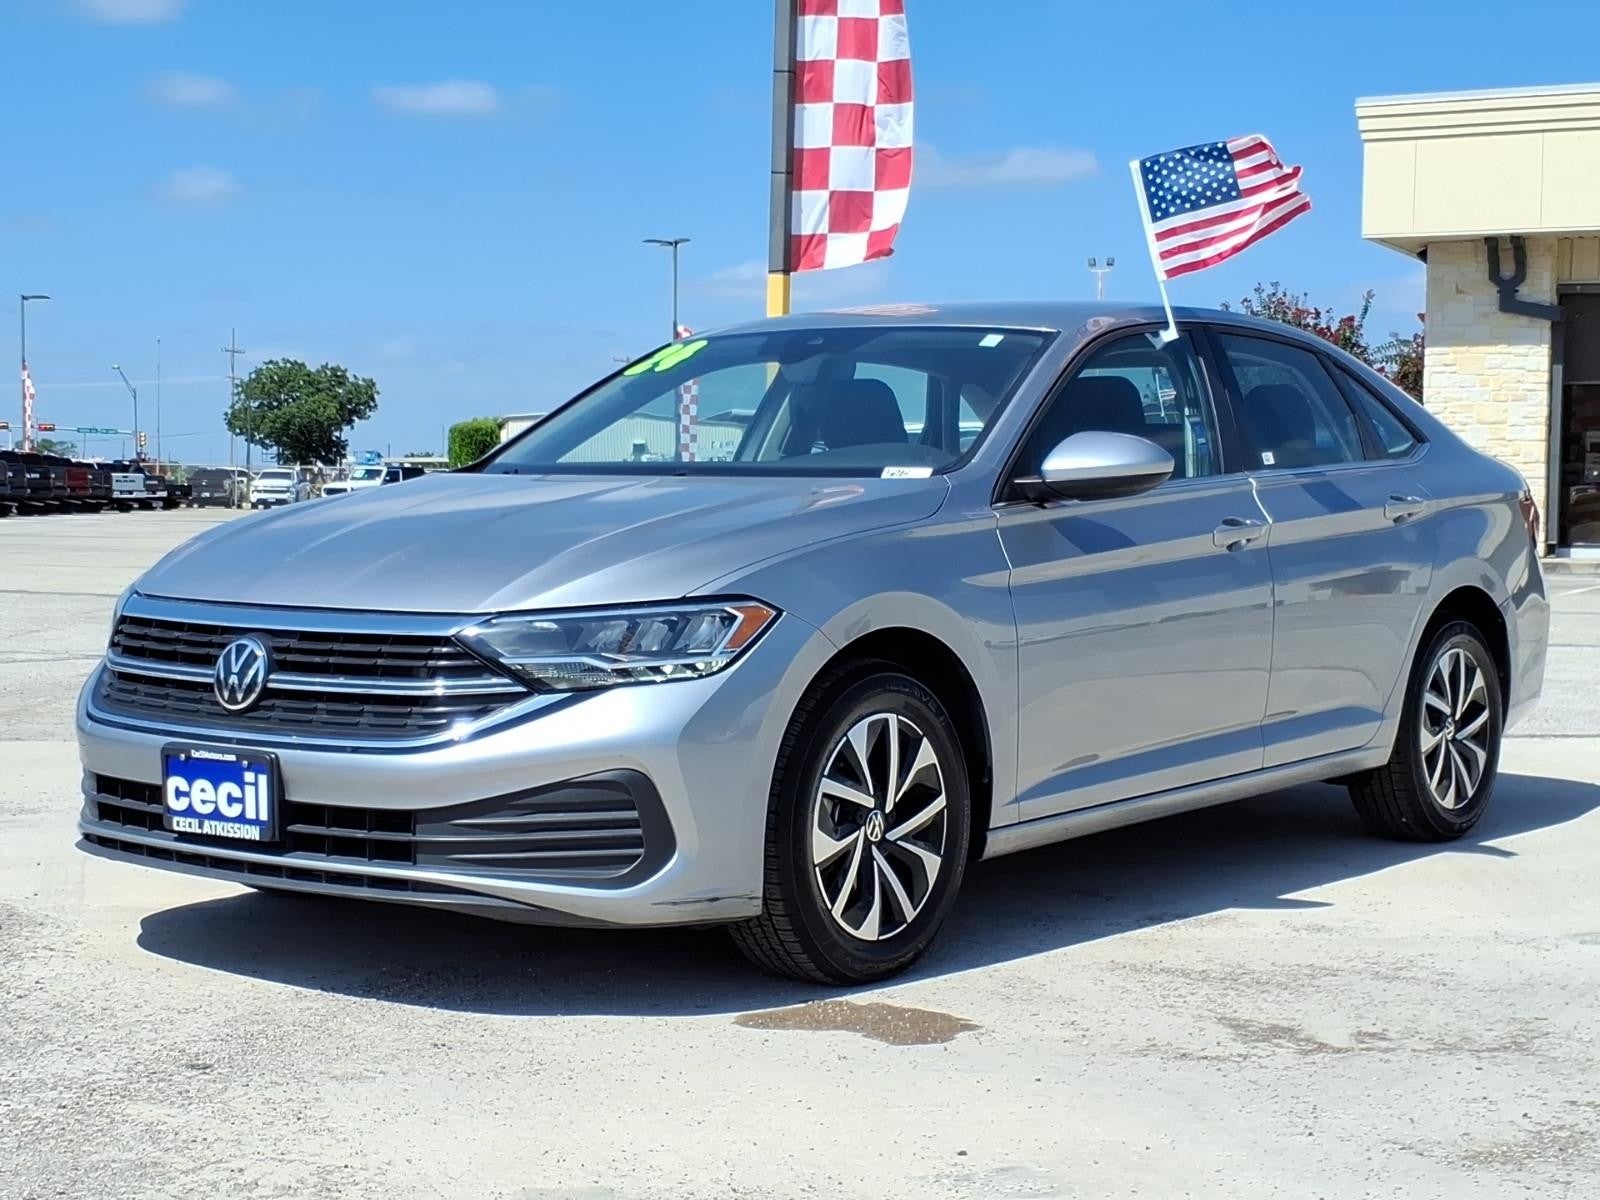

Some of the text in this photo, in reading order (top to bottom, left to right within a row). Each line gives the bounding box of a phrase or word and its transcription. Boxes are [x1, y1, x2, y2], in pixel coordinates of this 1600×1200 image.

[166, 771, 268, 821] cecil
[172, 816, 260, 841] CECIL ATKISSION
